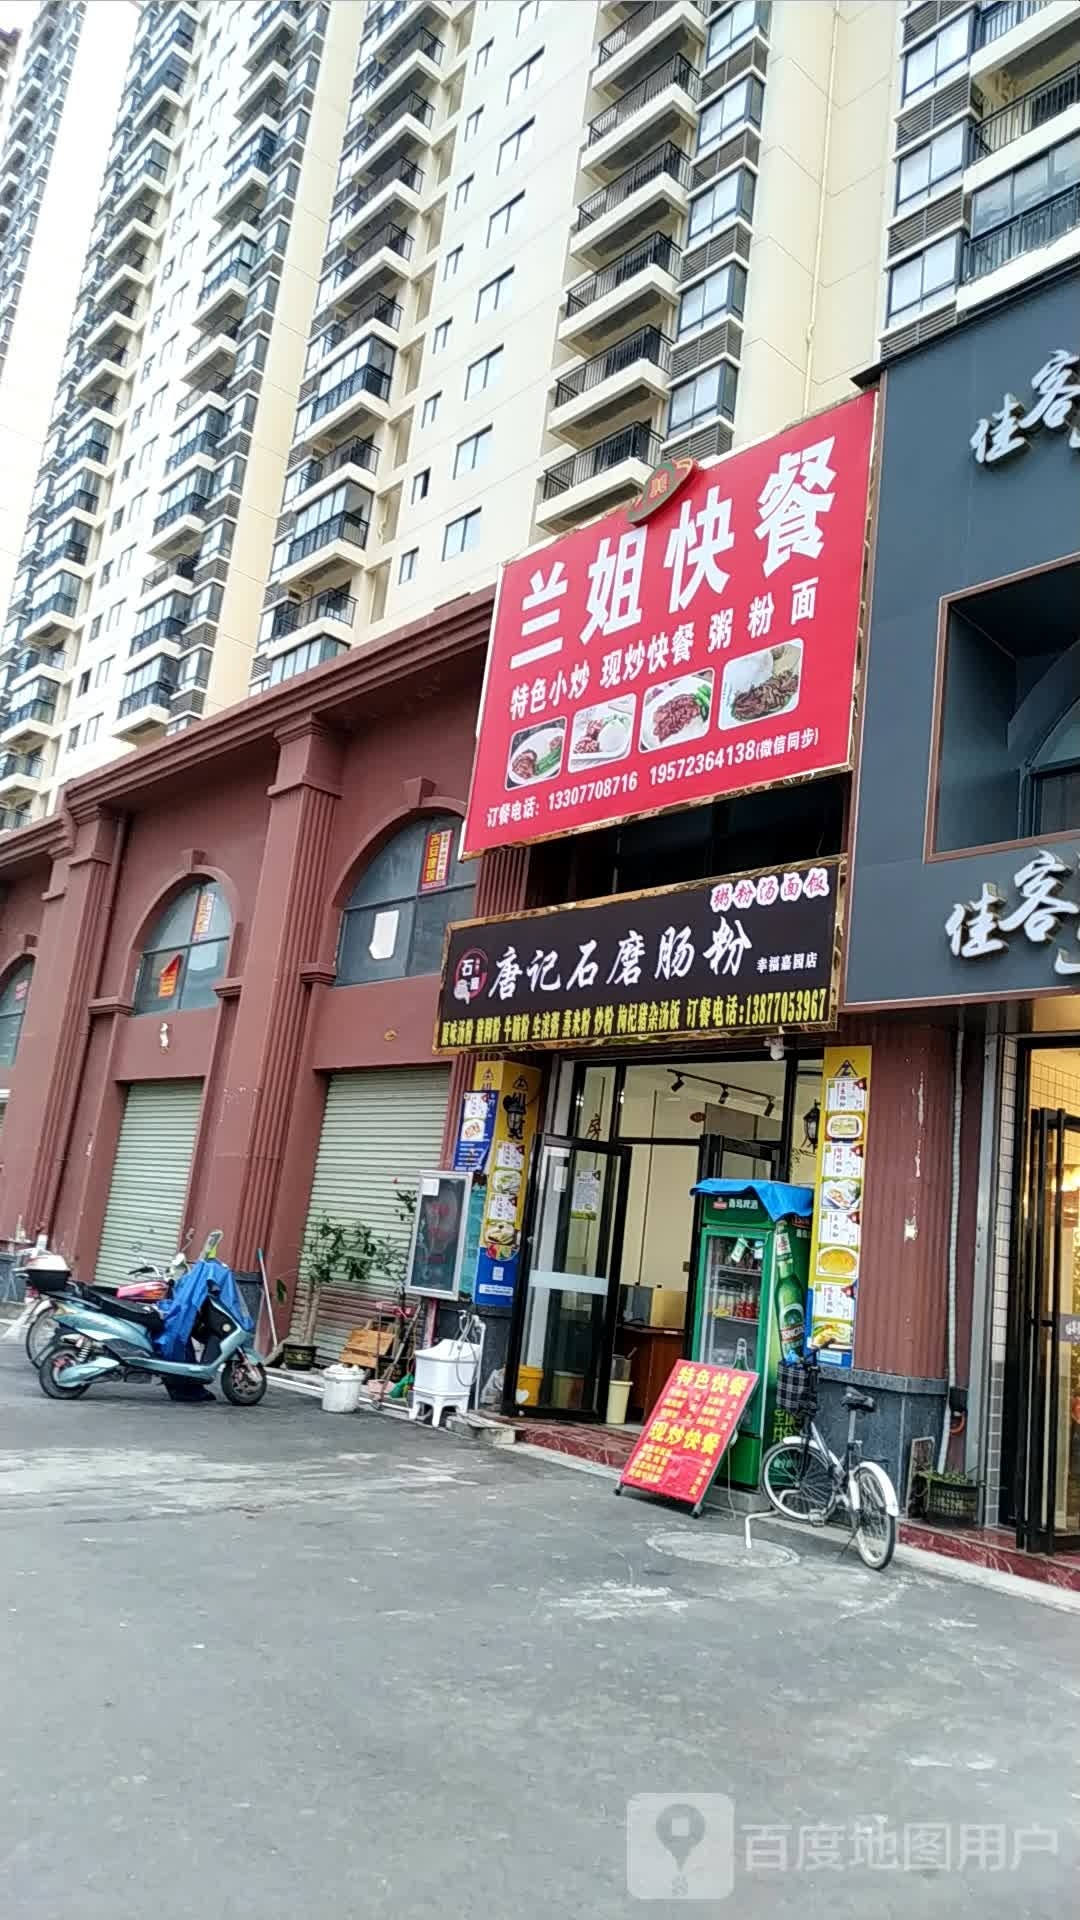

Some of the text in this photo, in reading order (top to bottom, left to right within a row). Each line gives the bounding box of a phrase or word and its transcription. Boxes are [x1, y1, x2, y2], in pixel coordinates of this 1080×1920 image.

[970, 348, 1080, 463] 佳客
[510, 435, 838, 669] 兰姐快餐
[509, 577, 819, 720] 特色小炒 现炒快餐 粥 粉 面
[548, 770, 638, 811] 13307708716
[711, 868, 829, 912] 粥粉汤面饭
[944, 849, 1080, 974] 佳客
[488, 916, 752, 1000] 唐记石磨肠粉
[757, 952, 818, 973] 幸福嘉园店
[676, 1366, 750, 1397] 特色快餐
[649, 1420, 721, 1455] 现炒快餐
